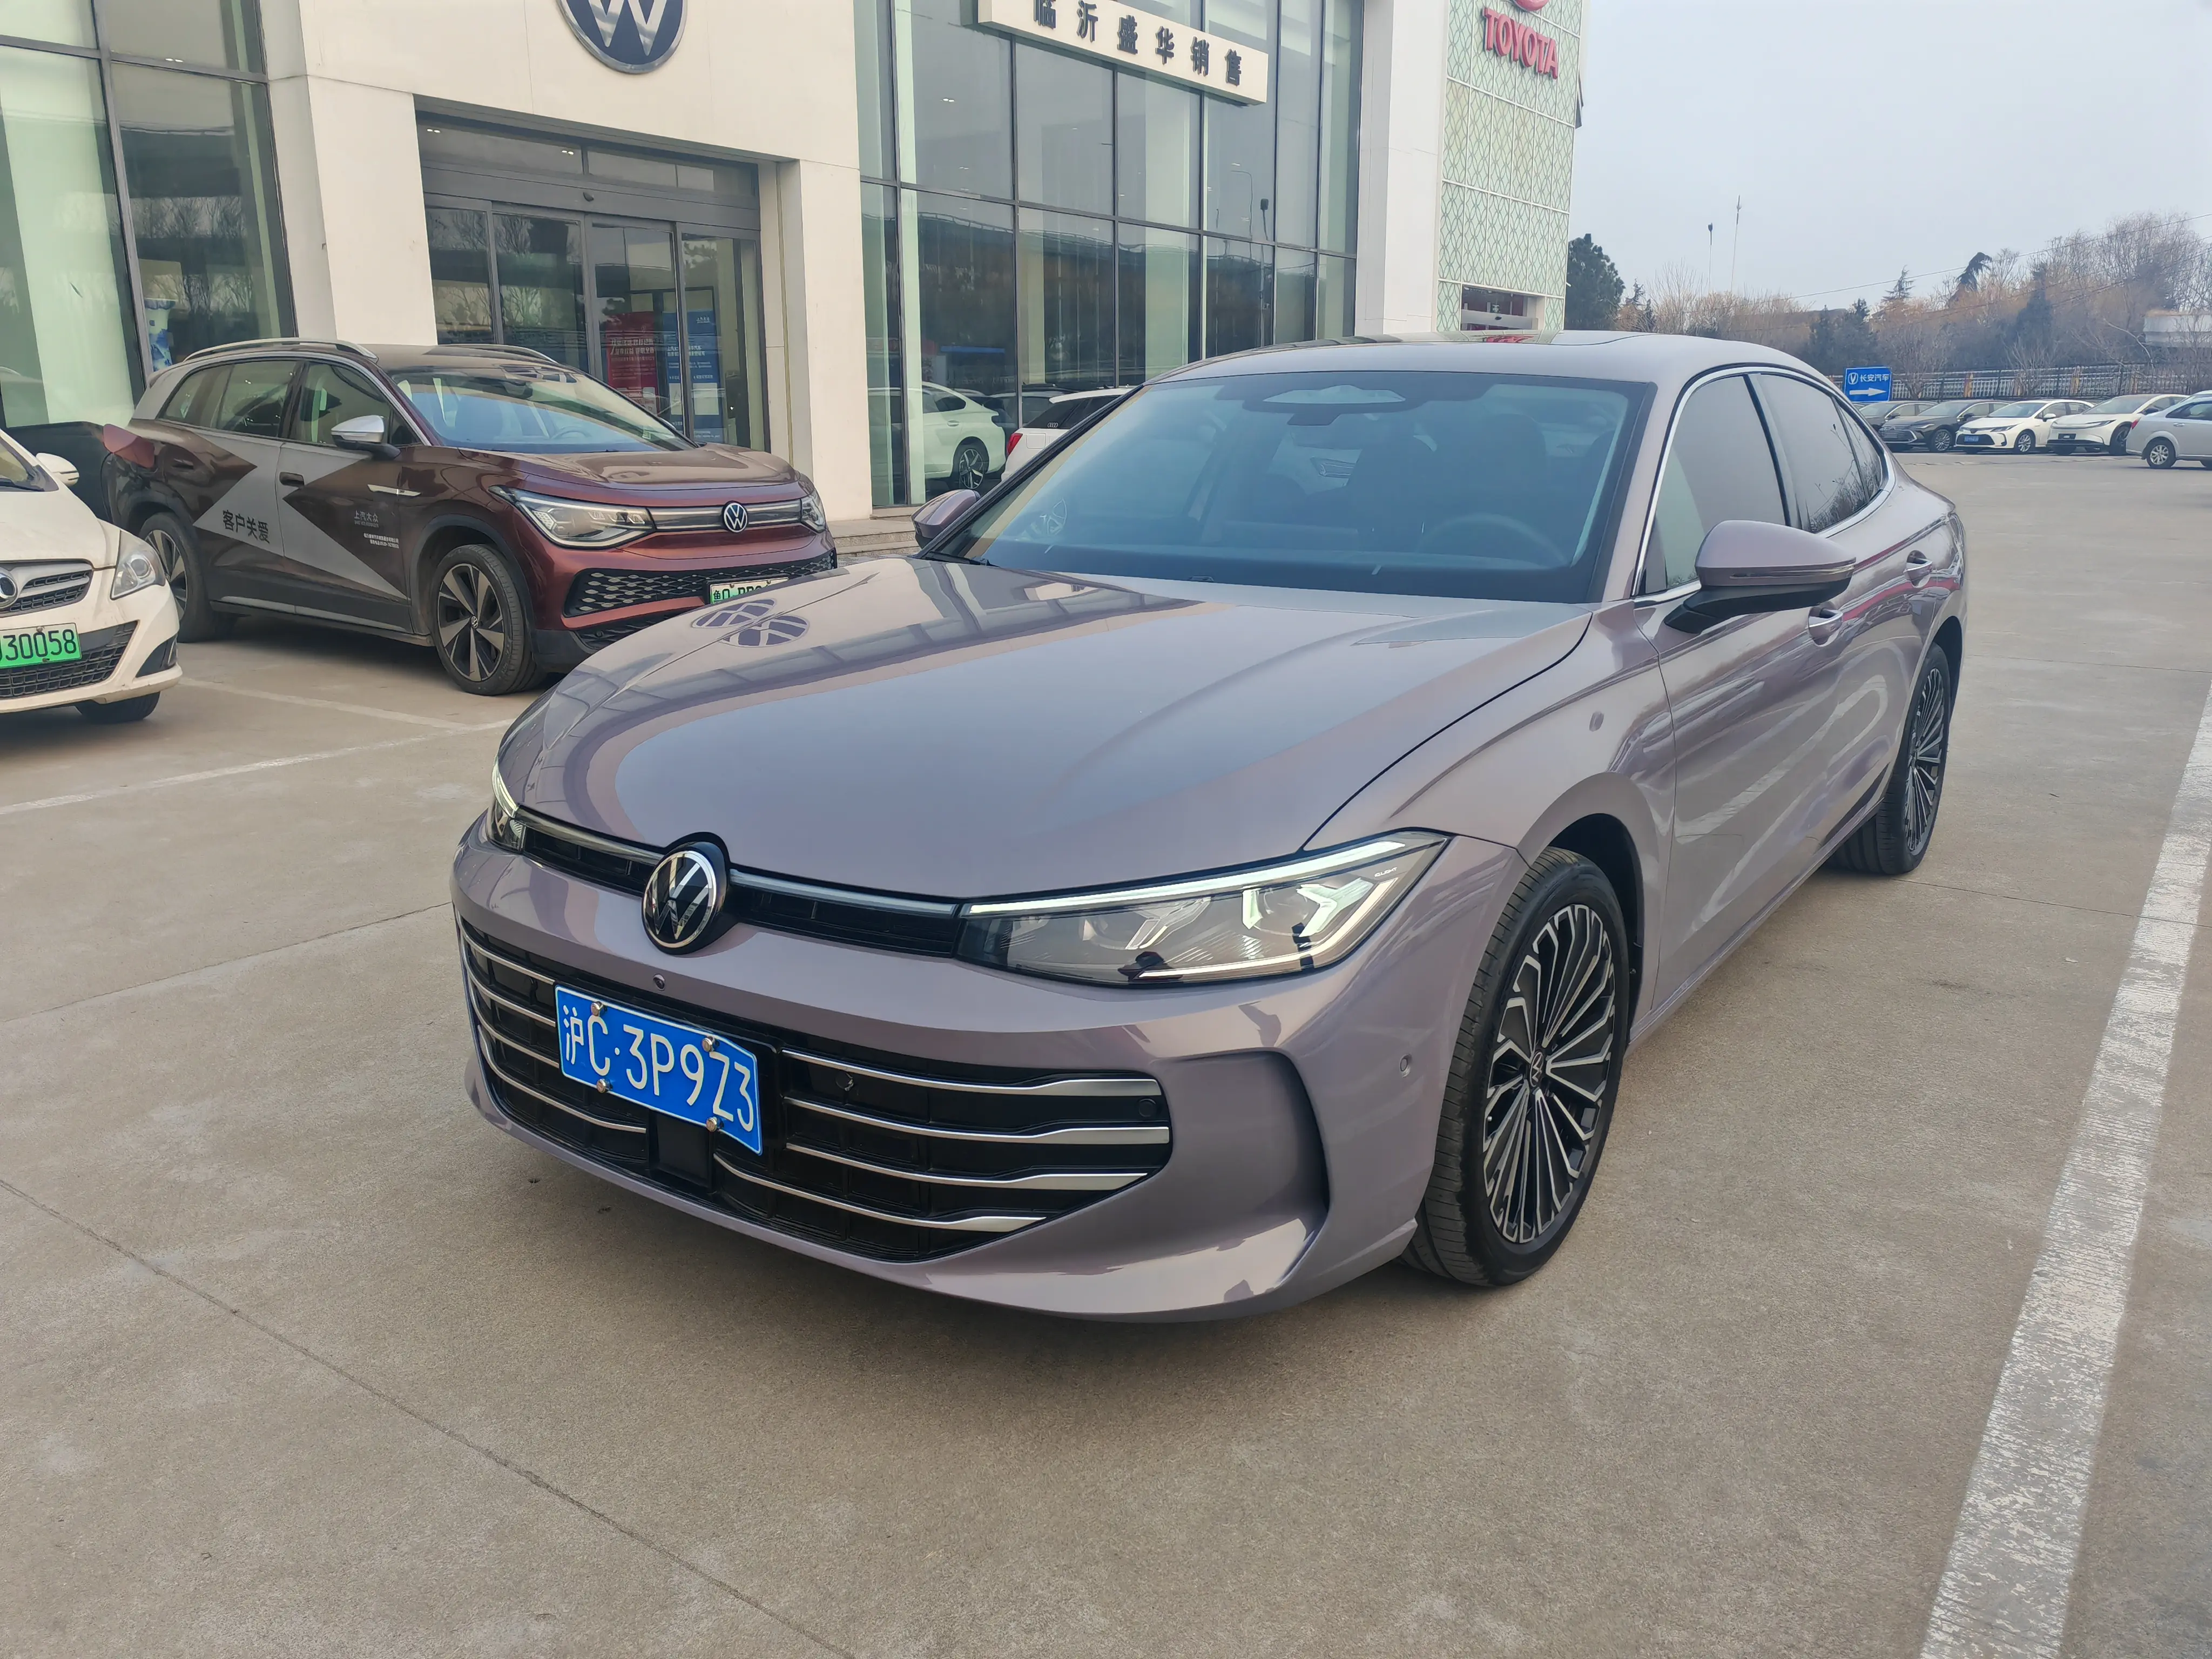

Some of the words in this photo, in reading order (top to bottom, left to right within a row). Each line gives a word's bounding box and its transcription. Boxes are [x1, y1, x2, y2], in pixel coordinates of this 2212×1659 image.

[1033, 0, 1242, 86] 临沂盛华销售
[1483, 6, 1558, 79] TOYOTA
[1860, 374, 1890, 382] 长安汽车
[222, 509, 270, 544] 客户关爱
[354, 510, 379, 523] 上汽大众
[0, 629, 77, 662] 30058
